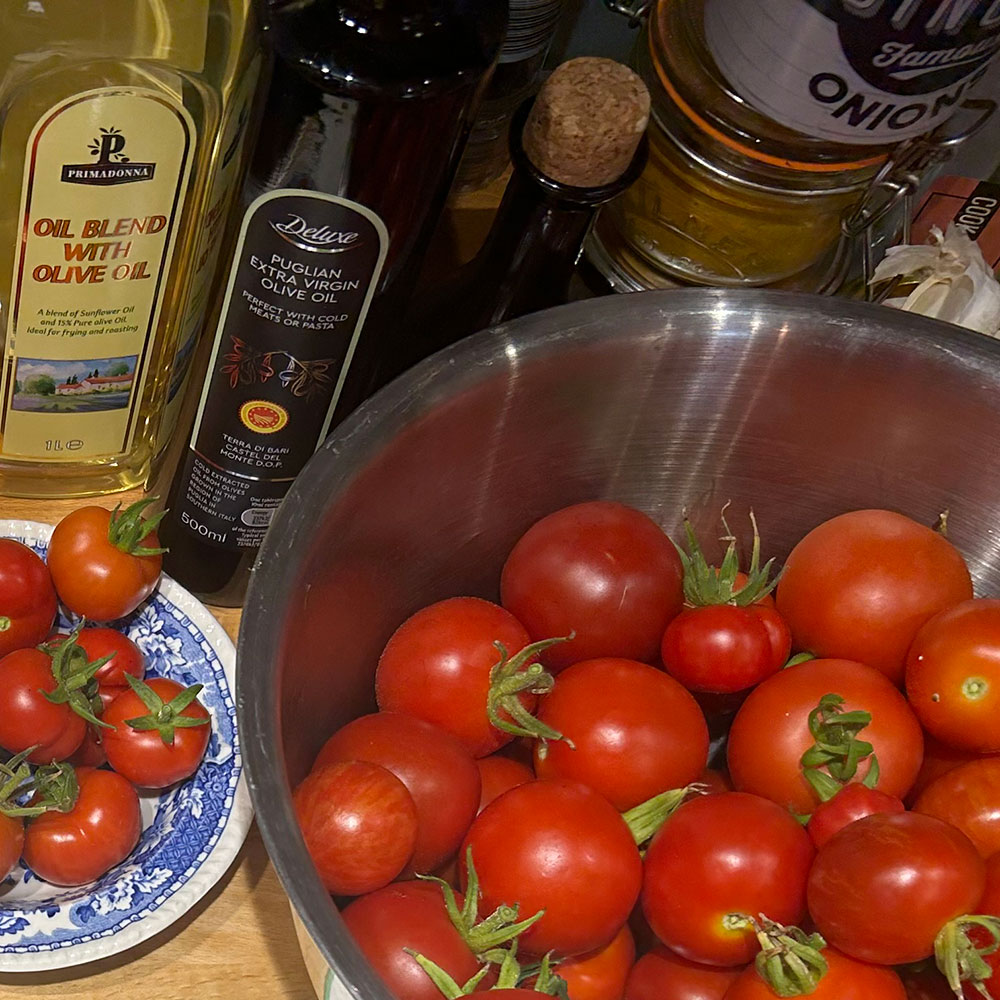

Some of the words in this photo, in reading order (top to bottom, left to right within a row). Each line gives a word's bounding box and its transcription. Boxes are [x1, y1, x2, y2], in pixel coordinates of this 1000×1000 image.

[68, 168, 148, 178] PRIMADONNA
[33, 218, 74, 238] OIL
[81, 215, 167, 238] BLEND
[276, 214, 358, 244] Deluxe
[64, 242, 131, 261] WITH
[32, 264, 108, 283] OLIVE
[111, 261, 151, 280] OIL
[250, 256, 297, 285] EXTRA
[304, 278, 360, 291] VIRGIN
[271, 254, 342, 278] PUGLIAN
[261, 278, 307, 300] OLIVE
[312, 293, 337, 303] OIL
[70, 310, 79, 318] of
[80, 309, 120, 318] Sunflower
[123, 306, 135, 314] Oil
[242, 290, 283, 314] PERFECT
[286, 310, 315, 322] WITH
[318, 314, 348, 322] COLD
[248, 304, 280, 323] MEATS
[284, 319, 300, 328] OR
[302, 322, 334, 330] PASTA
[27, 326, 46, 334] Ideal
[47, 328, 60, 337] for
[62, 328, 87, 337] frying
[106, 325, 138, 334] roasting
[223, 433, 251, 449] TERRA
[226, 444, 260, 459] CASTEL
[220, 449, 254, 465] MONTE
[192, 467, 202, 477] OIL
[203, 474, 220, 488] FROM
[221, 484, 245, 496] OLIVES
[194, 459, 210, 474] COLD
[211, 471, 250, 489] EXTRACTED
[188, 486, 208, 505] PUGLIA
[189, 480, 211, 499] REGION
[191, 473, 214, 492] GROWN
[224, 492, 237, 501] THE
[186, 493, 217, 517] SOUTHERN
[218, 513, 237, 522] ITALY
[181, 511, 227, 543] 500ml
